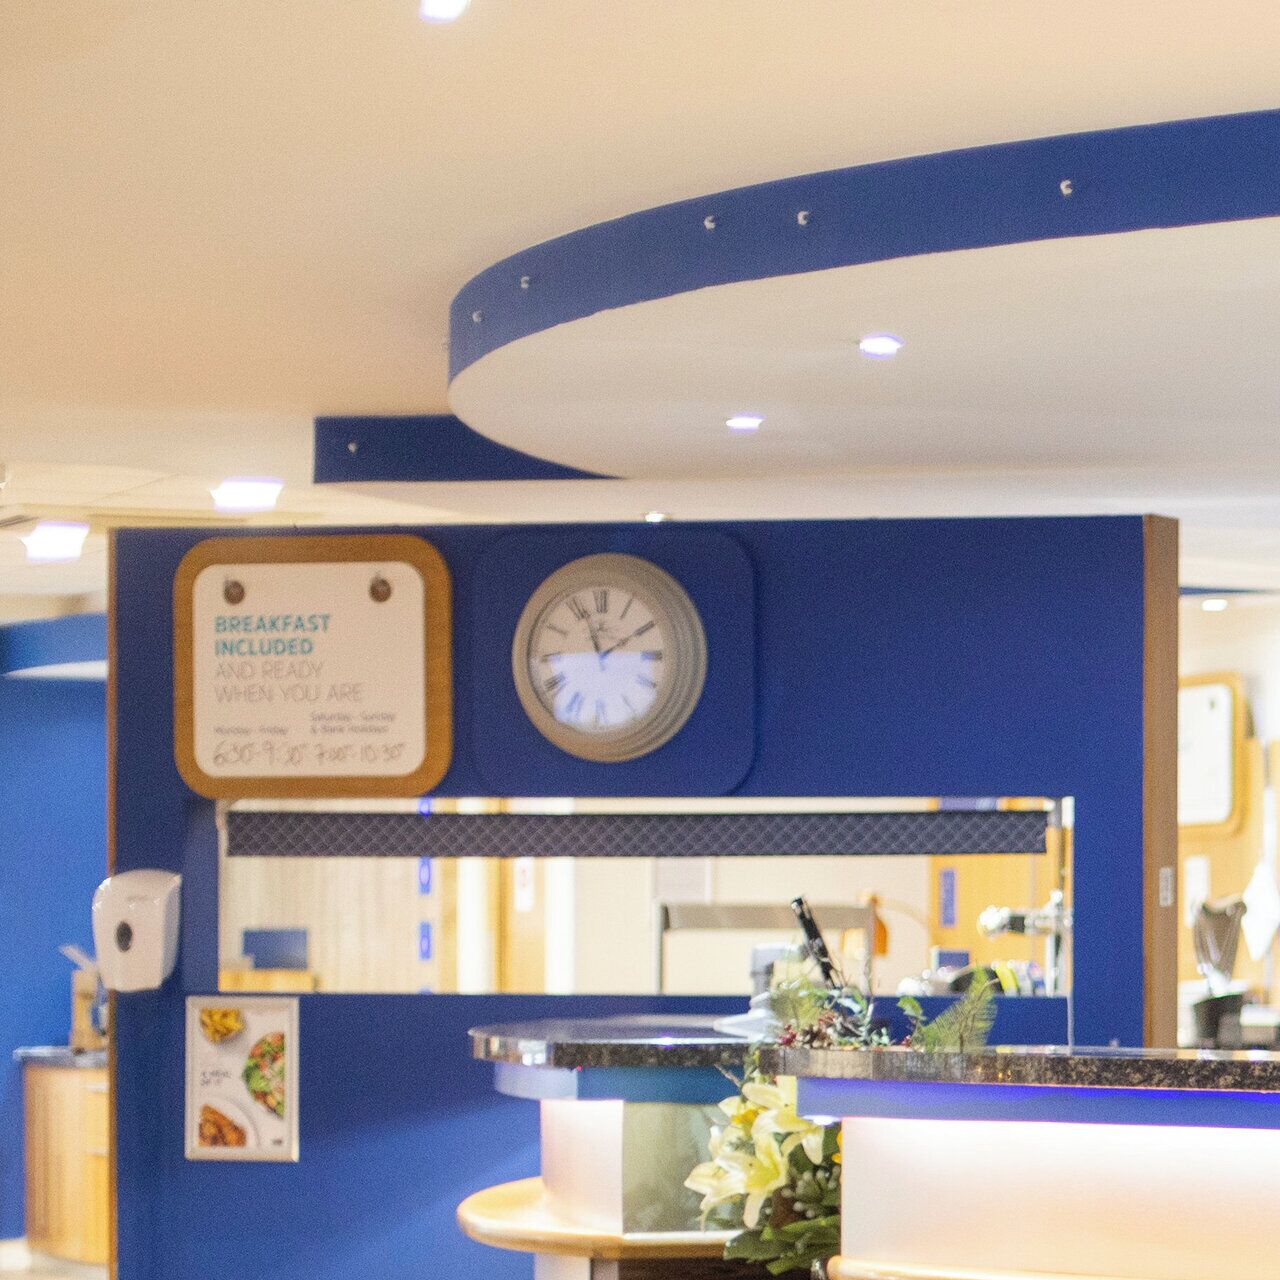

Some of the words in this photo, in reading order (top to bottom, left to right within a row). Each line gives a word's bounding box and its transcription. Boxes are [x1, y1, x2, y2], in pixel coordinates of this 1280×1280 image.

[214, 614, 331, 633] BREAKFAST
[214, 638, 314, 656] INCLUDED
[215, 661, 255, 680] AND
[261, 661, 325, 680] READY
[214, 684, 274, 703] WHEN
[279, 684, 321, 703] YOU
[327, 682, 364, 703] ARE
